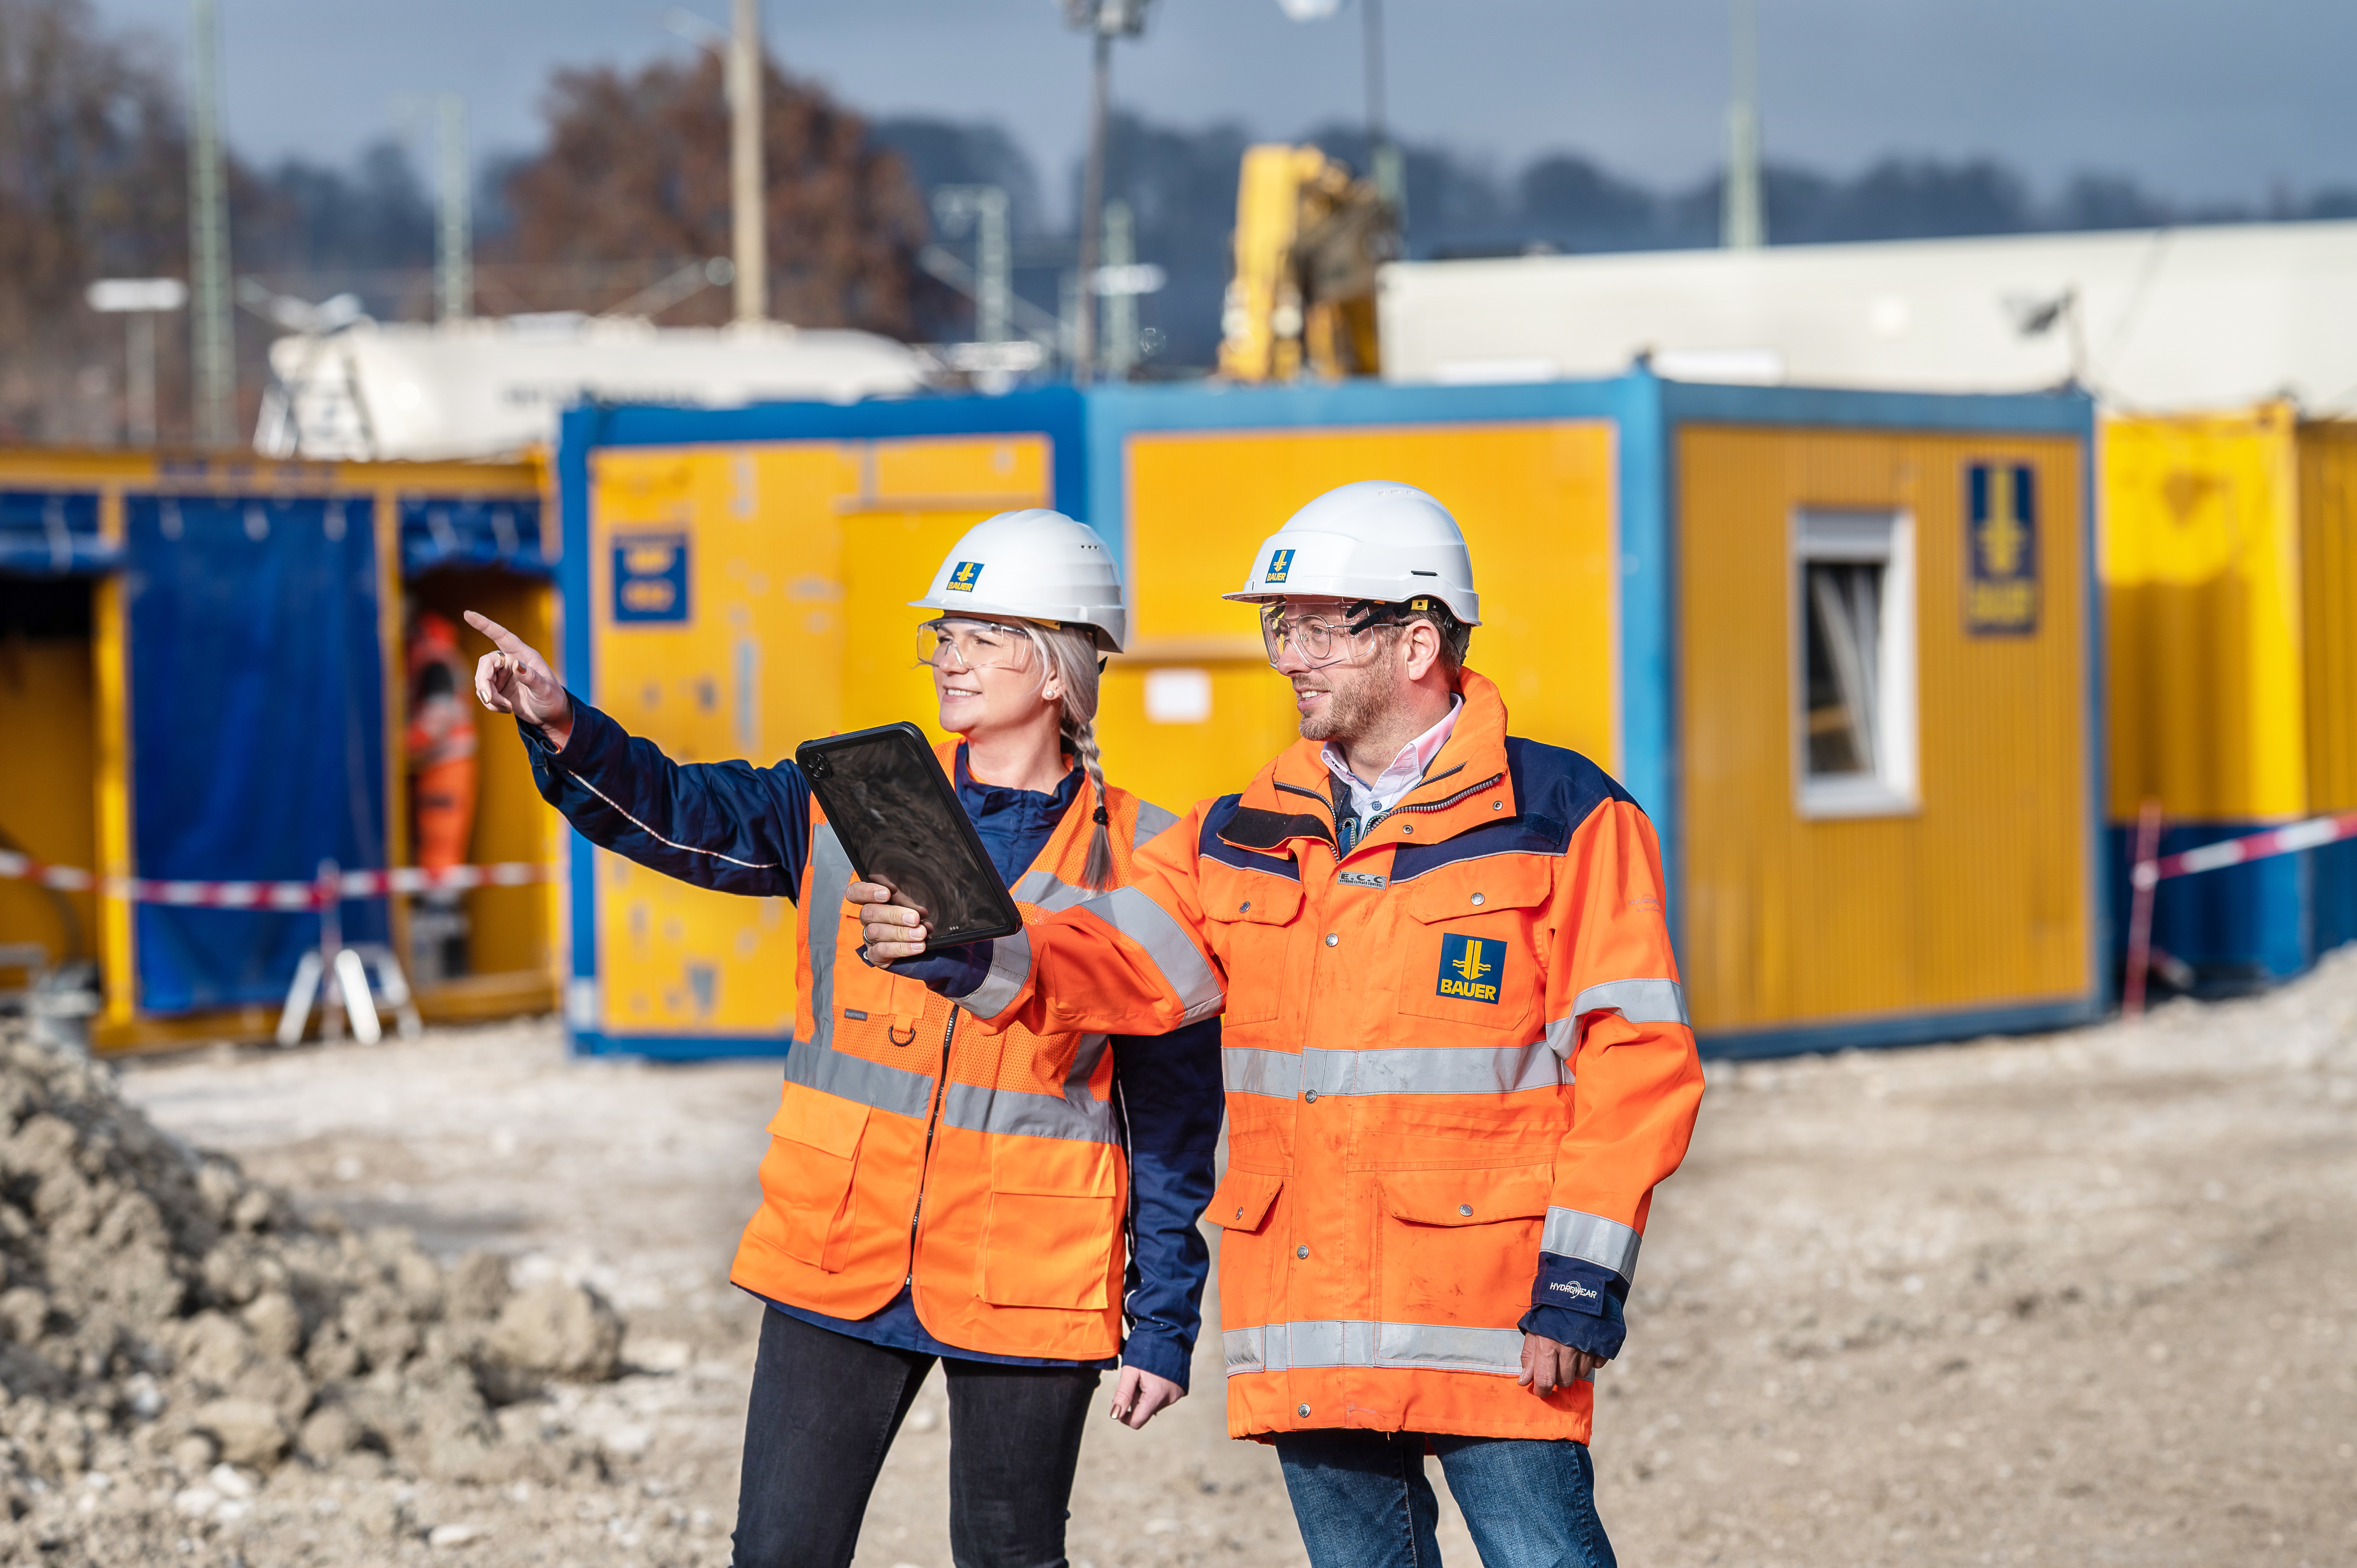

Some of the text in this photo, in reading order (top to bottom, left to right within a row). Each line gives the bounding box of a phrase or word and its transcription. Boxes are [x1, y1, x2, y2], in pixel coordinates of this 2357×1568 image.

[1267, 572, 1286, 581] BAUER
[947, 582, 973, 592] BAUER
[1440, 978, 1496, 1000] BAUER
[1550, 1282, 1597, 1299] HYDROWEAR
